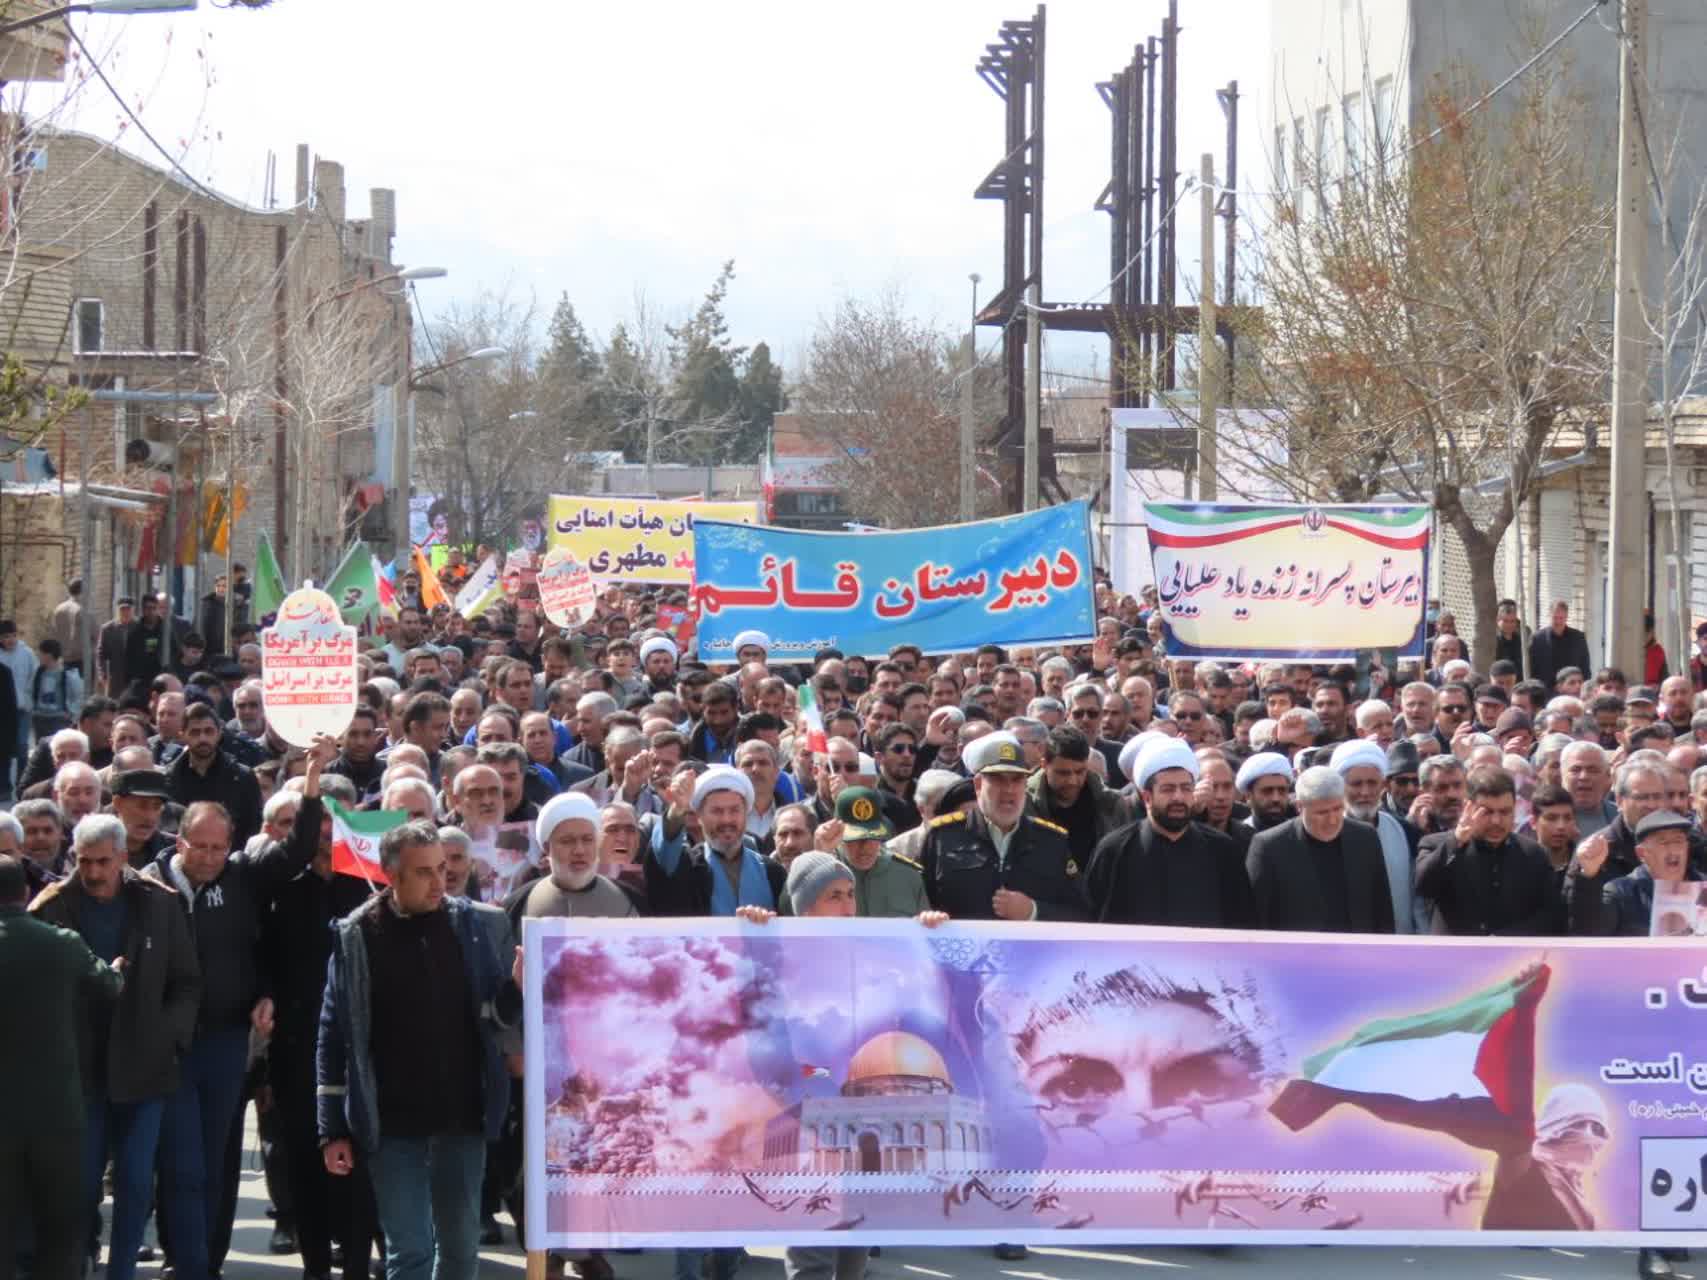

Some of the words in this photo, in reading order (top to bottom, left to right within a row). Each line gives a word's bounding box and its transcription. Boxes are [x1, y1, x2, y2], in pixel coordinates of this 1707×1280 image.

[589, 543, 666, 573] مطهری
[690, 556, 859, 621] قائم
[875, 551, 1079, 617] دبیرستان
[1604, 1055, 1681, 1081] است
